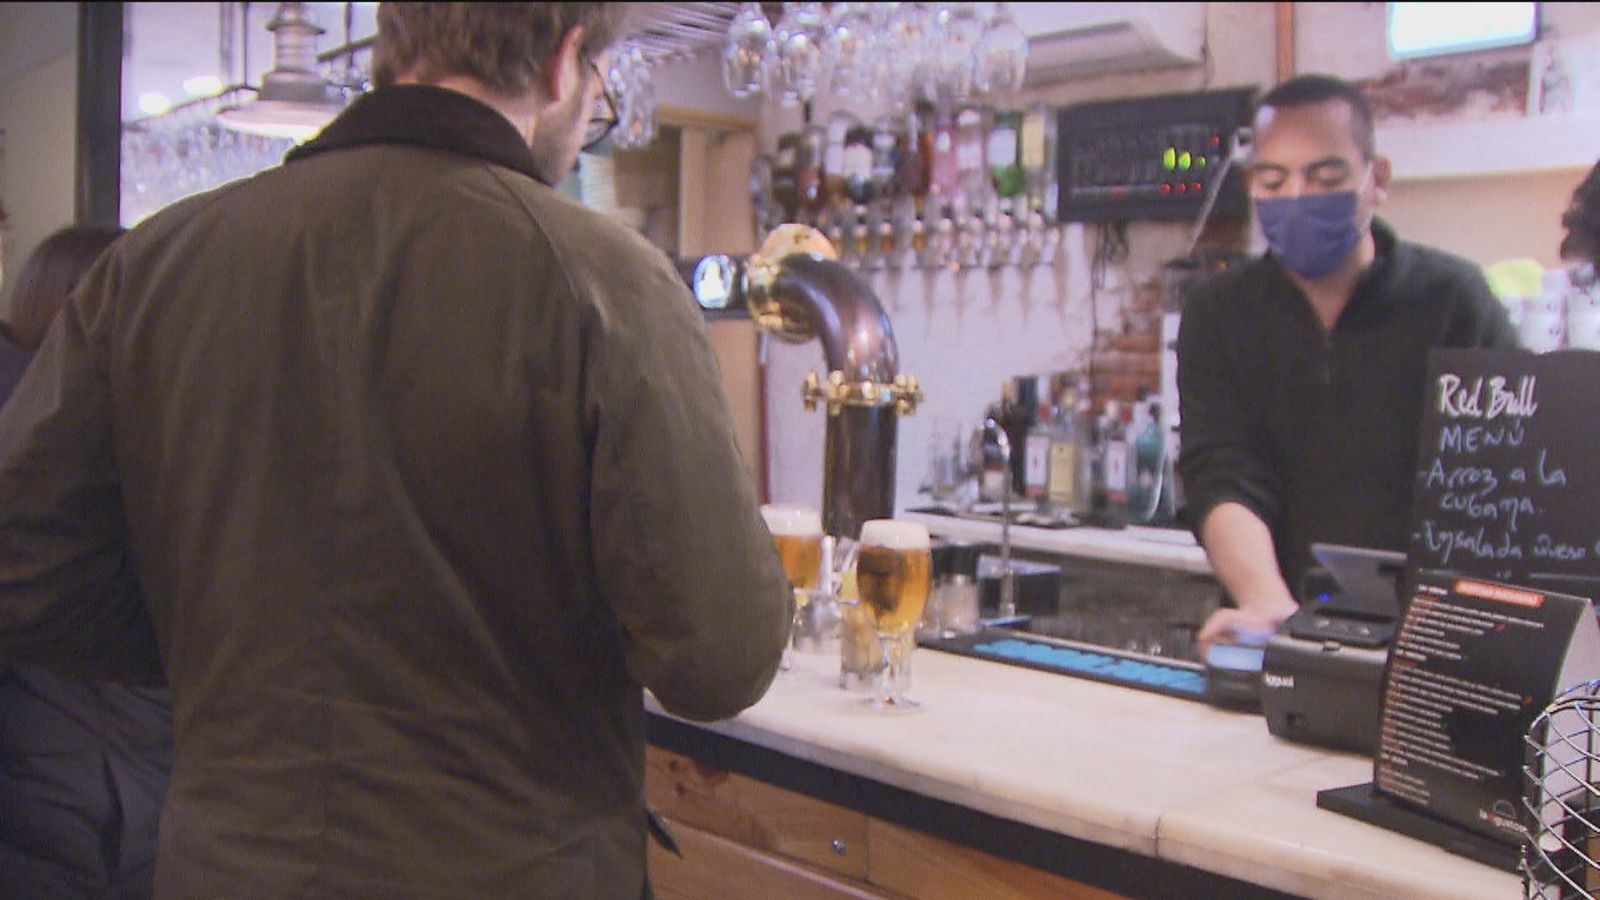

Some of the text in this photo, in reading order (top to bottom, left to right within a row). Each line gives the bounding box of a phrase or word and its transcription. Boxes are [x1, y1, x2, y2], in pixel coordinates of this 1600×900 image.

[1439, 373, 1538, 419] Red Bull
[1510, 467, 1526, 482] a
